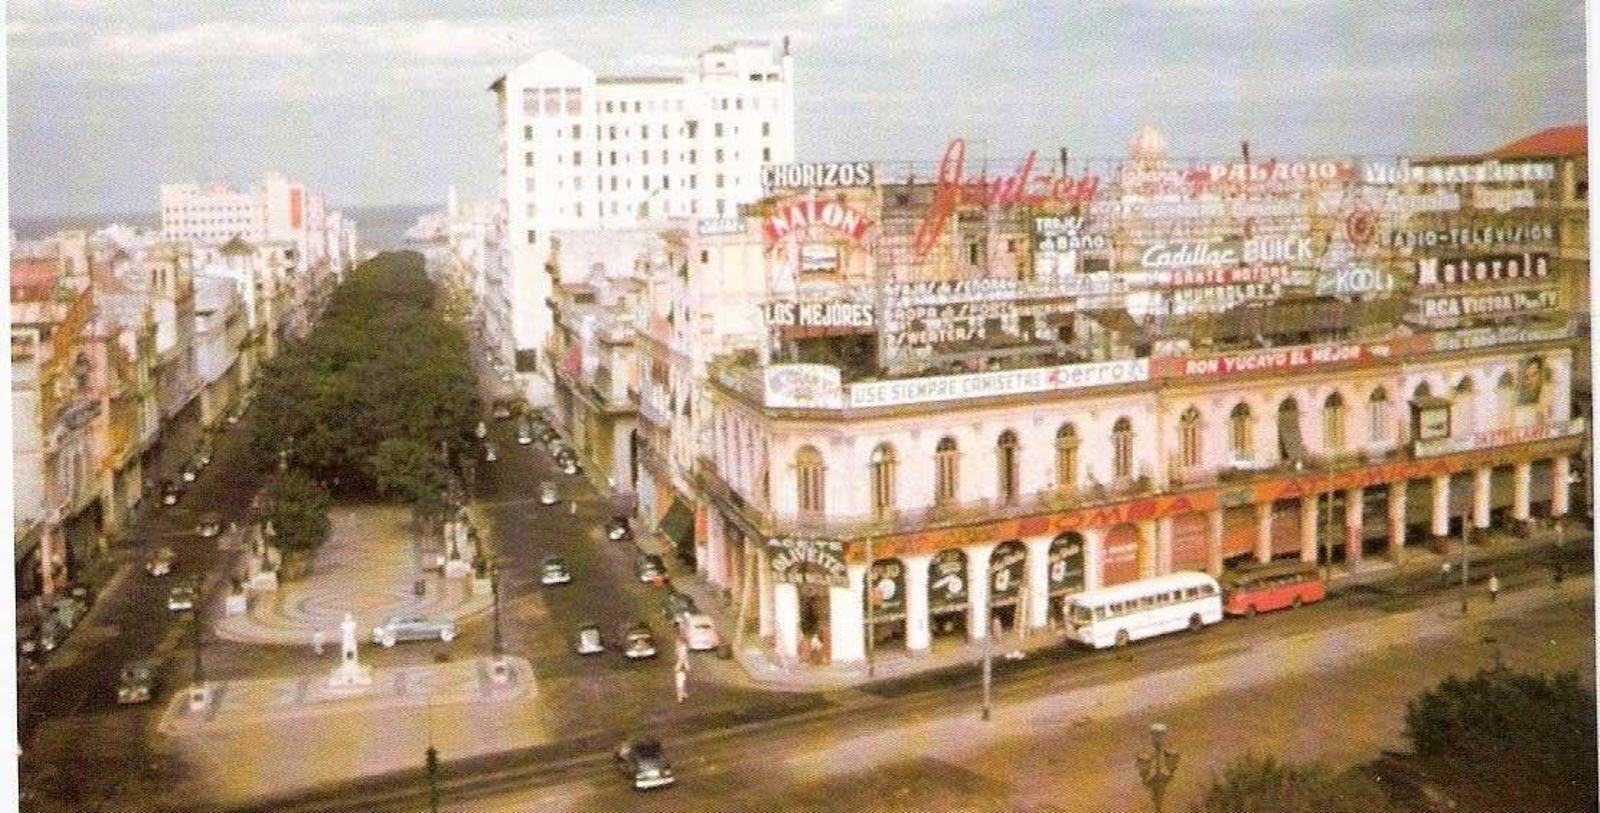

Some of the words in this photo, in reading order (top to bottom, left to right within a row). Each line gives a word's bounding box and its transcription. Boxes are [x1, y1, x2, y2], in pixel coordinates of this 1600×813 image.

[761, 162, 871, 187] CHORIZOS
[1141, 243, 1240, 268] Cadillac
[1244, 238, 1313, 263] BUICK
[1335, 267, 1382, 292] KOOL
[1418, 253, 1548, 284] Motorola
[764, 303, 796, 325] LOS
[1185, 358, 1220, 375] RON
[1223, 353, 1286, 371] YUCAYO
[1290, 350, 1307, 366] EL
[1311, 345, 1360, 363] MEJOR
[855, 384, 887, 405] USE
[891, 377, 956, 401] SIEMPRE
[962, 370, 1042, 394] CAMISETAS
